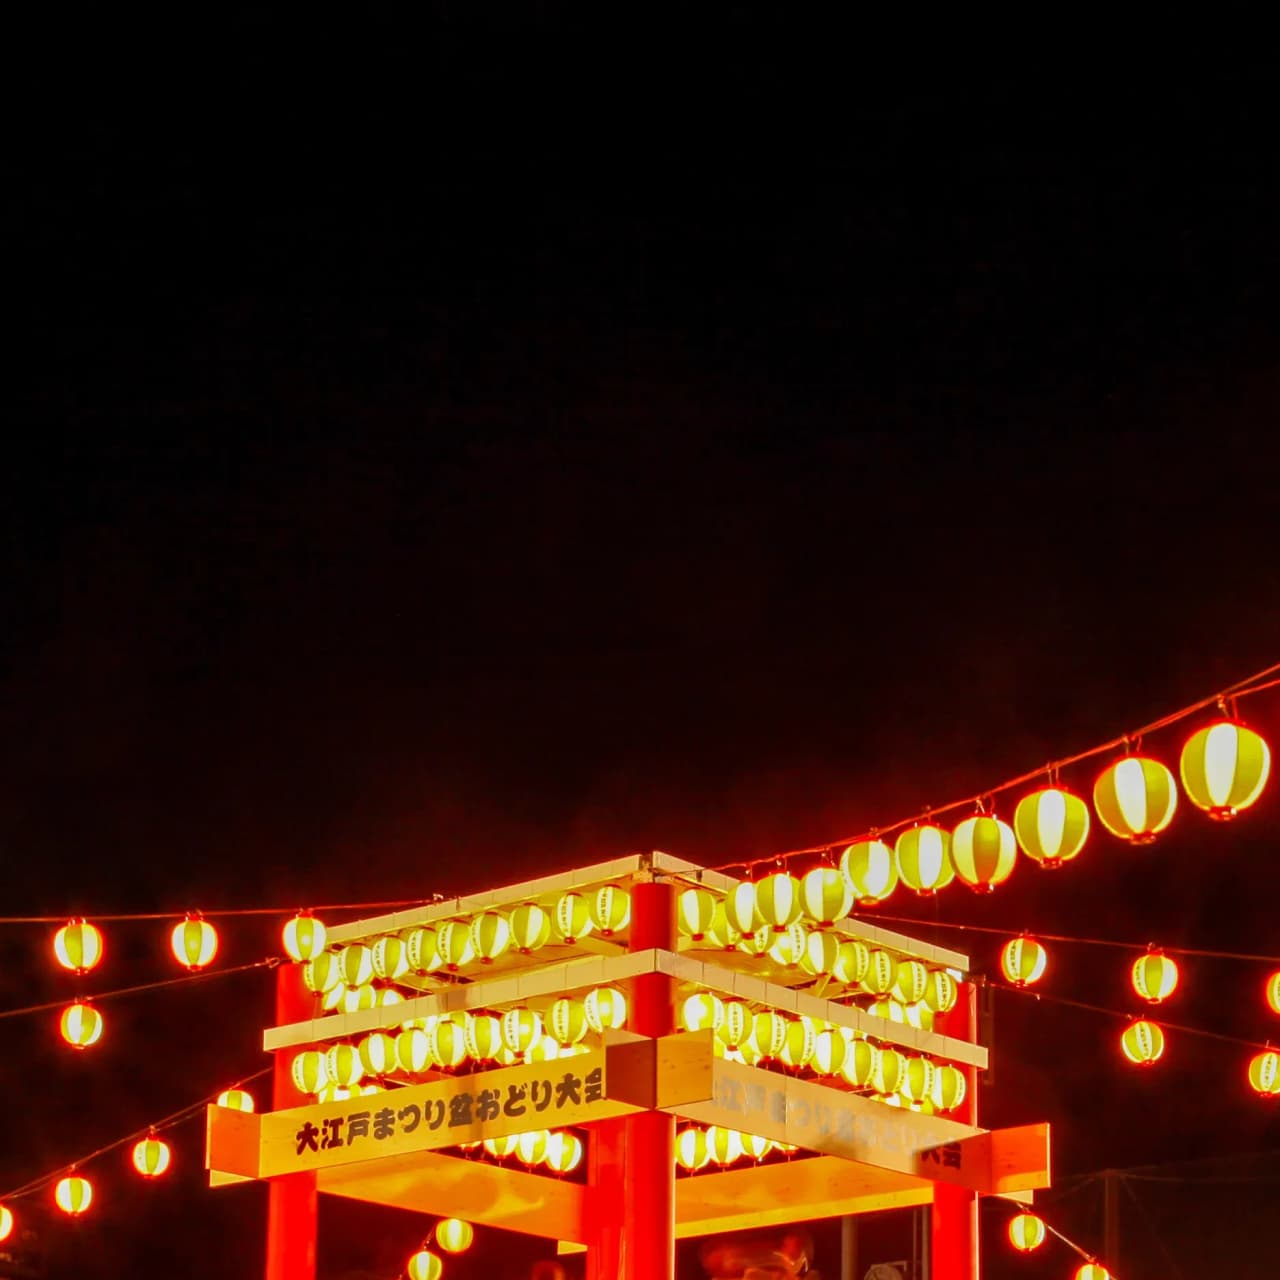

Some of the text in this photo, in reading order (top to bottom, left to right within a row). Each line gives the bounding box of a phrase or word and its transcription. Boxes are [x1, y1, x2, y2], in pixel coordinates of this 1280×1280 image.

[296, 1067, 602, 1156] 大江戸まつり盆おどり大会
